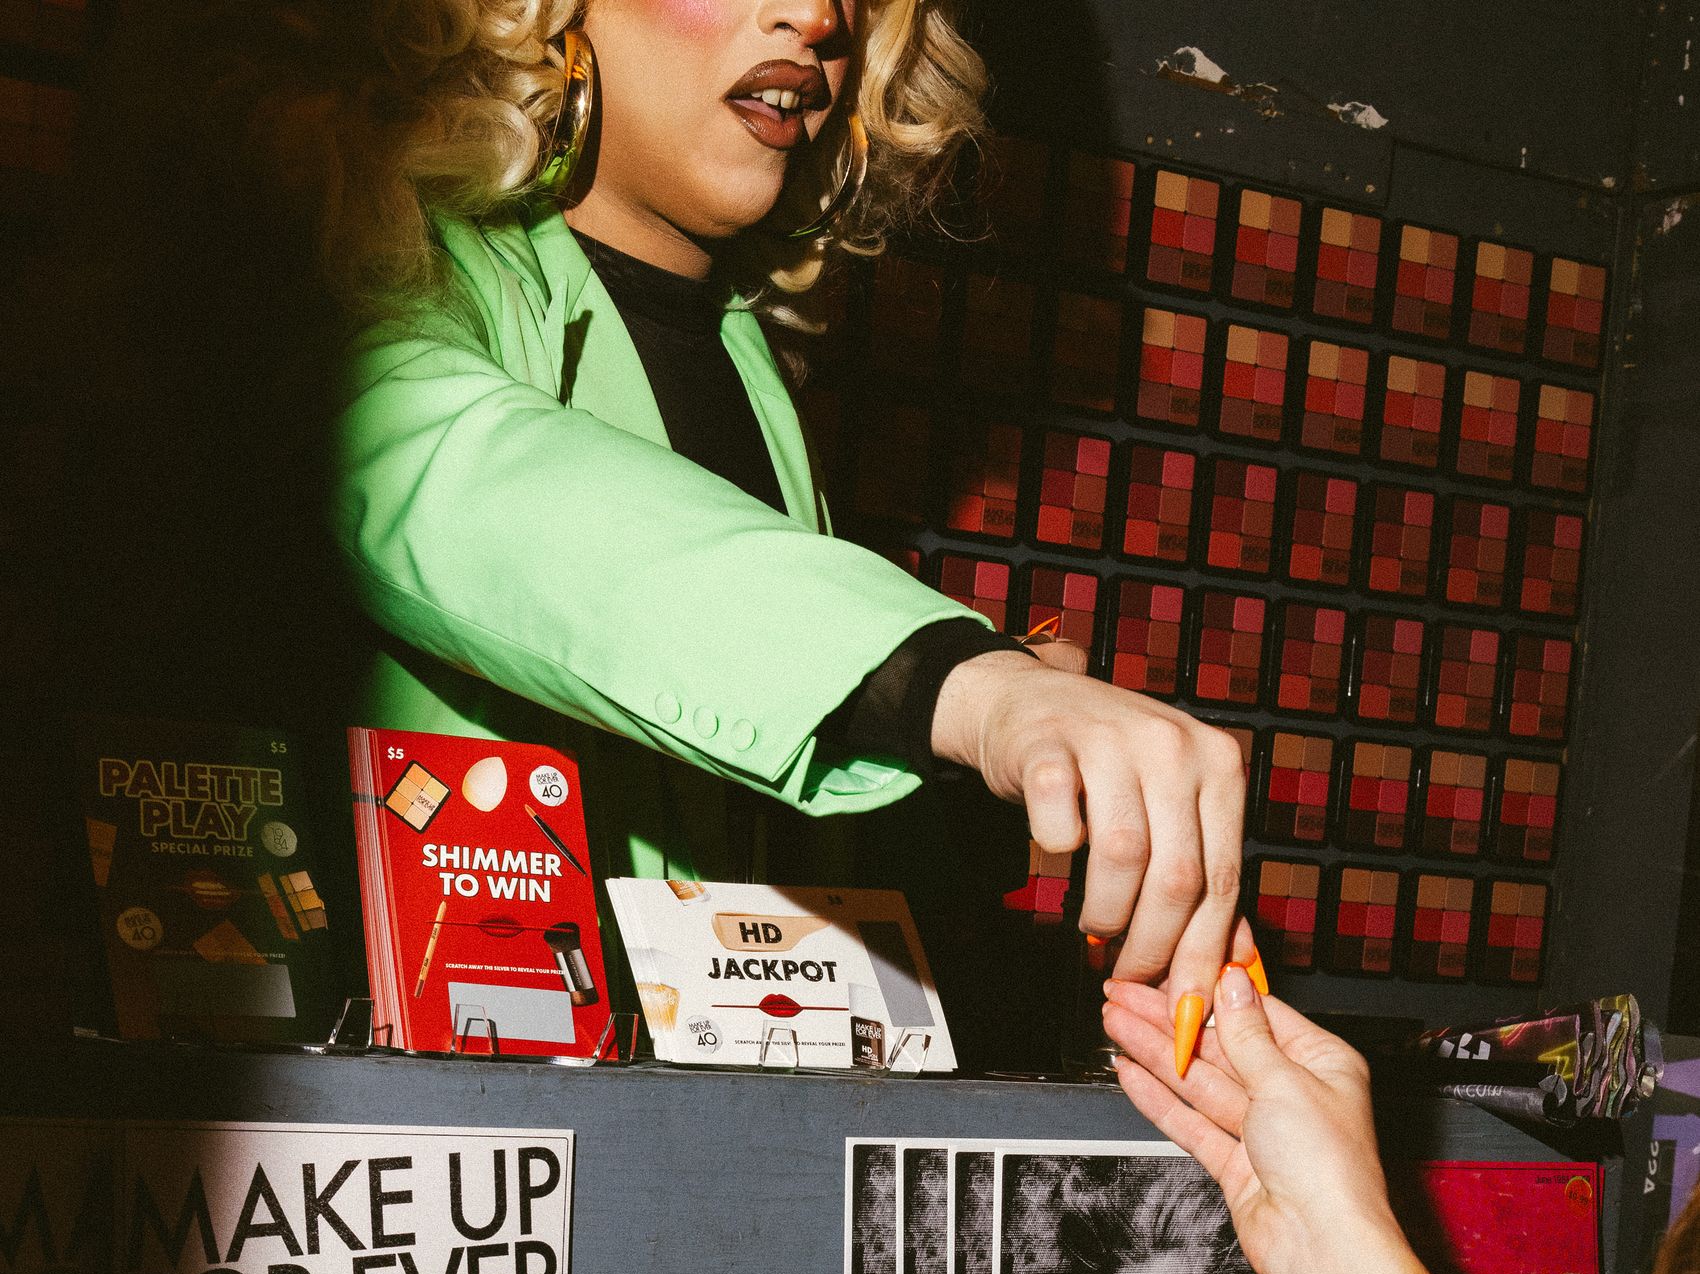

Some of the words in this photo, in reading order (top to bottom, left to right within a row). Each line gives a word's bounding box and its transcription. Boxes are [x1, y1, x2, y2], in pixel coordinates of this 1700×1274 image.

[387, 746, 404, 760] $5
[100, 758, 283, 806] PALETTE
[542, 784, 563, 798] 40
[141, 799, 257, 841] PLAY
[151, 841, 210, 855] SPECIAL
[214, 845, 254, 857] PRIZE
[422, 843, 562, 877] SHIMMER
[439, 872, 480, 897] TO
[486, 875, 551, 903] WIN
[738, 921, 783, 945] HD
[707, 957, 838, 983] JACKPOT
[697, 1032, 717, 1047] 40
[861, 1045, 873, 1054] HD
[128, 1155, 416, 1271] MAKE
[449, 1146, 562, 1242] UP
